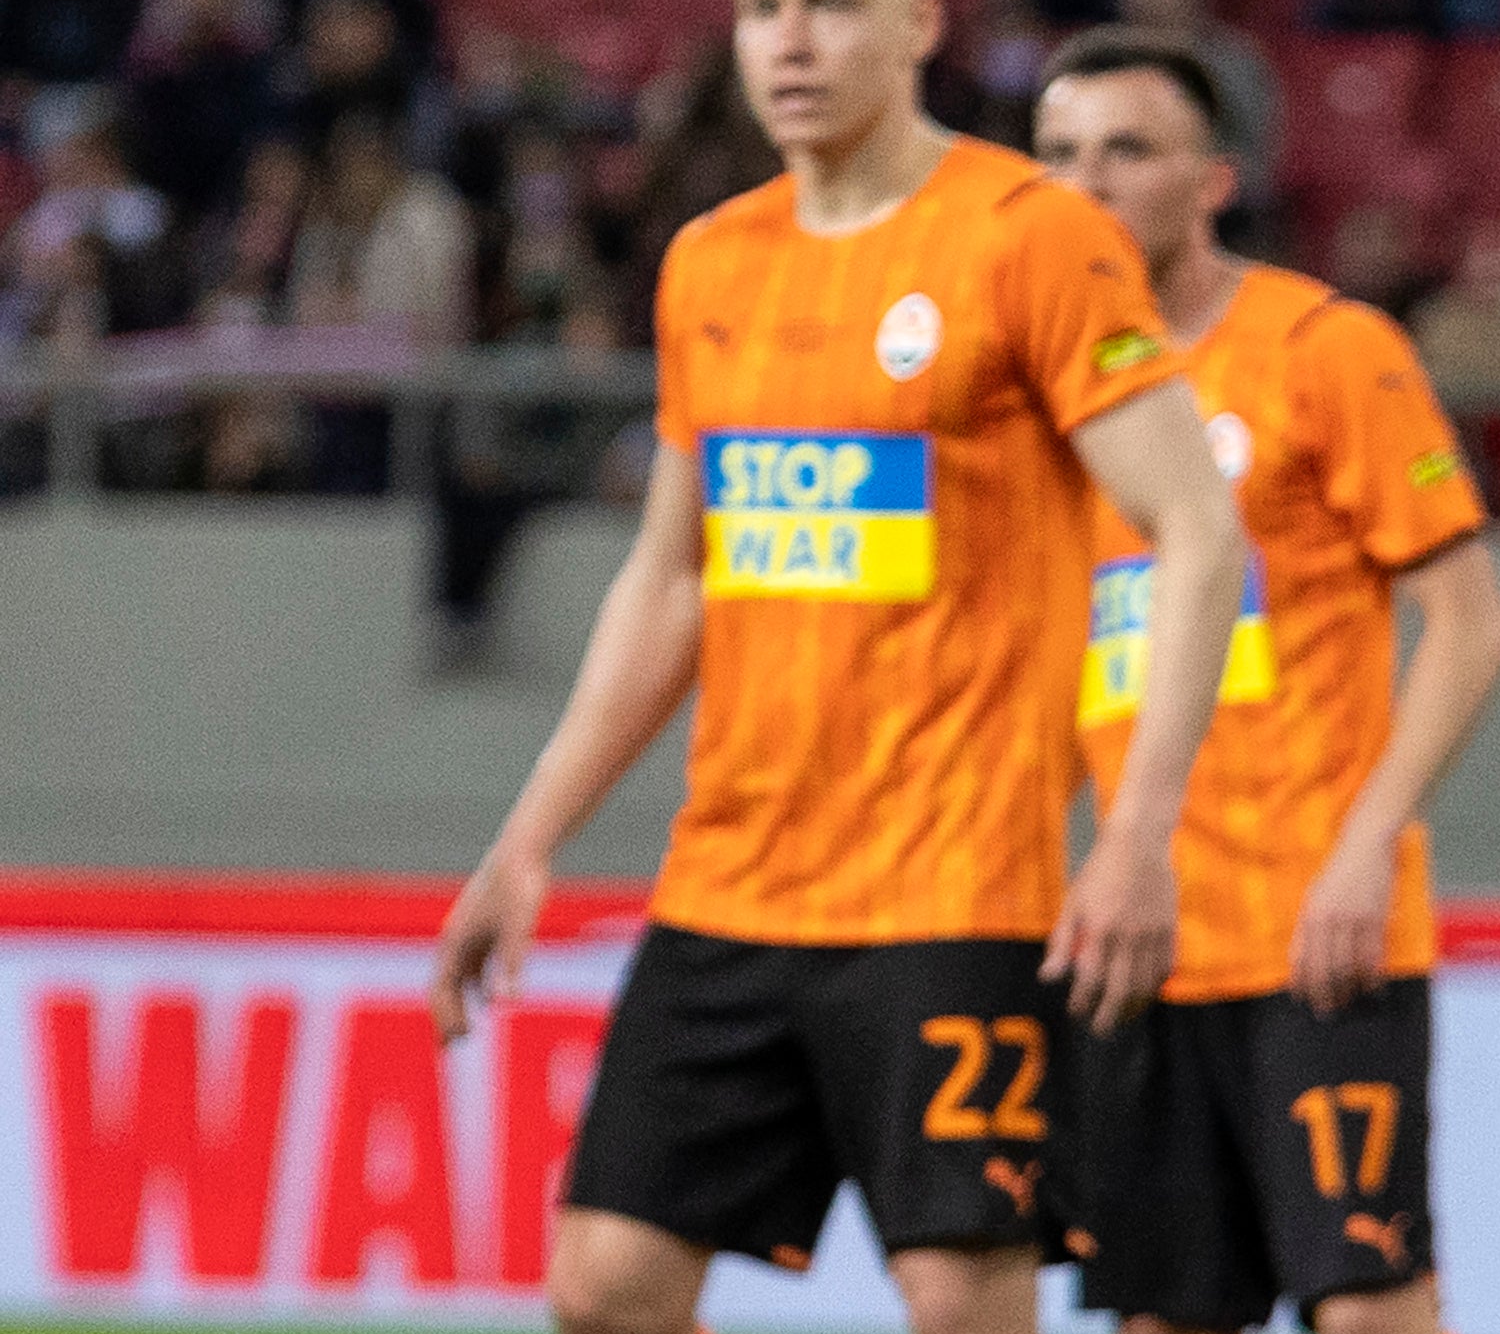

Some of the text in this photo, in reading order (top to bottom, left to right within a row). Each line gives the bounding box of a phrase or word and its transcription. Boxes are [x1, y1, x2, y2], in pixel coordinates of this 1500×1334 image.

[717, 441, 873, 508] STOP
[730, 525, 863, 582] WAR
[921, 1016, 1048, 1141] 22
[1290, 1082, 1399, 1199] 17
